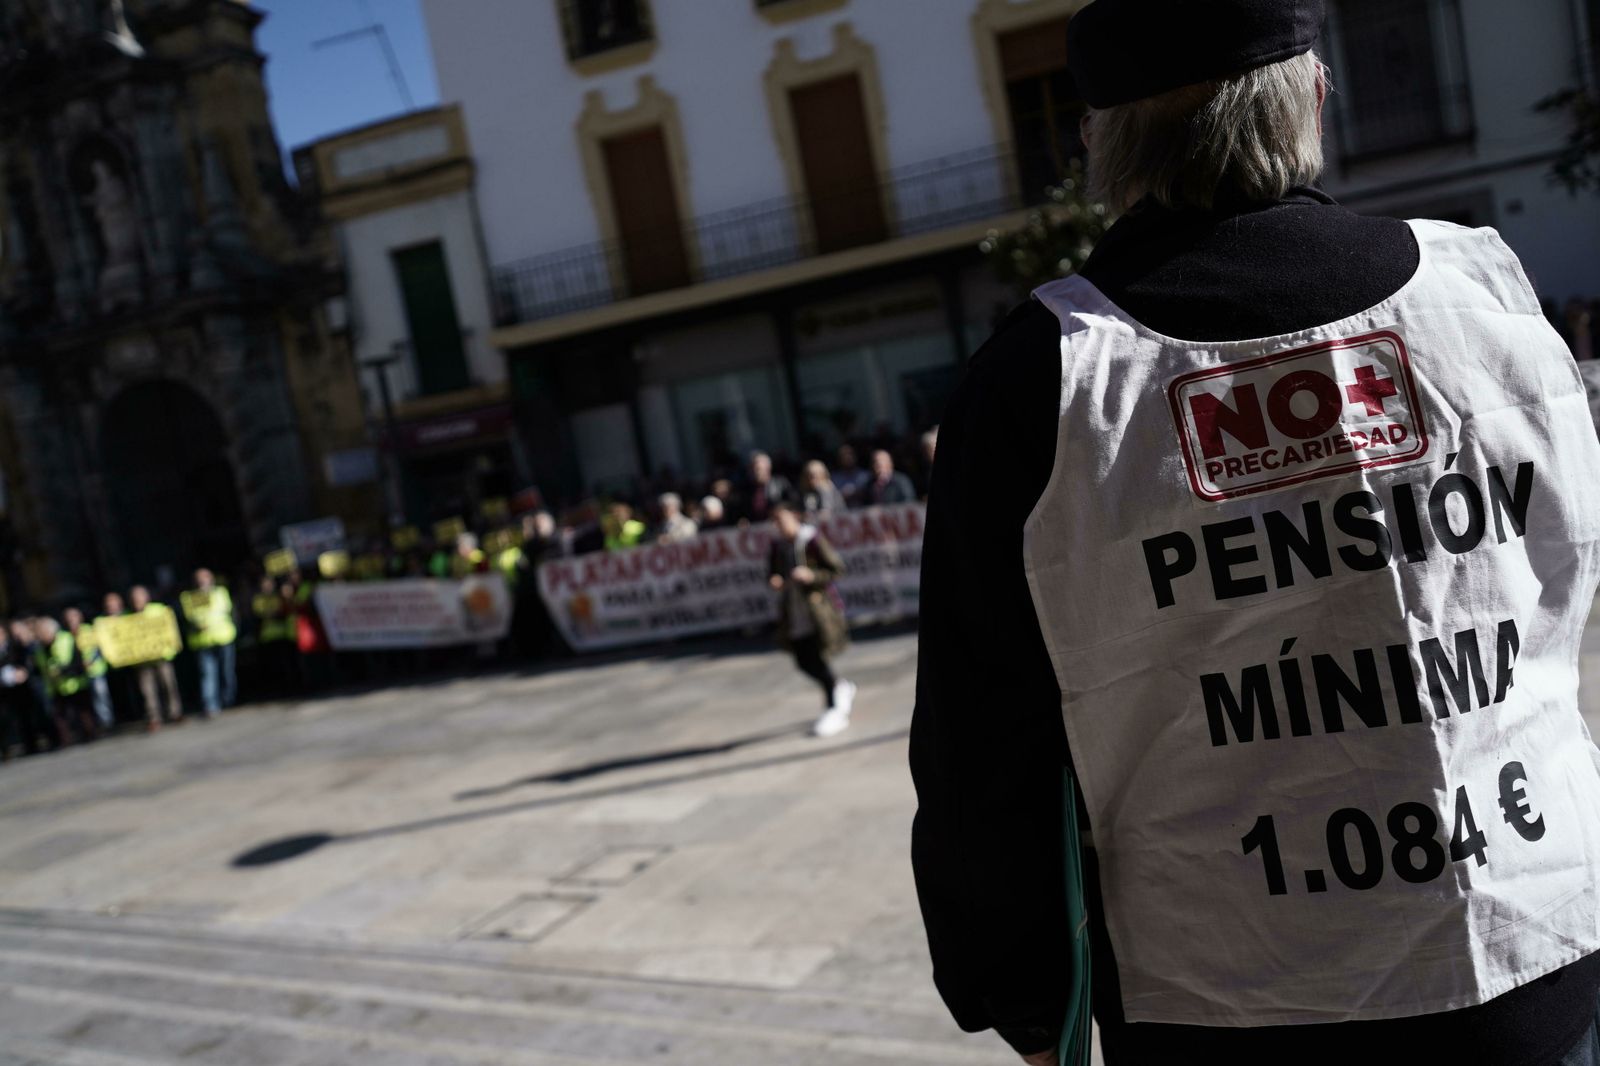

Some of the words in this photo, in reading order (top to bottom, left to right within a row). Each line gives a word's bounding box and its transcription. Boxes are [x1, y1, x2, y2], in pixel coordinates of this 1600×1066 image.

[1206, 423, 1408, 483] PRECARIEDAD
[1141, 452, 1534, 610] PENSIÓN
[1200, 618, 1520, 747] MÍNIMA
[1241, 784, 1488, 896] 1.084
[1497, 760, 1546, 842] €
